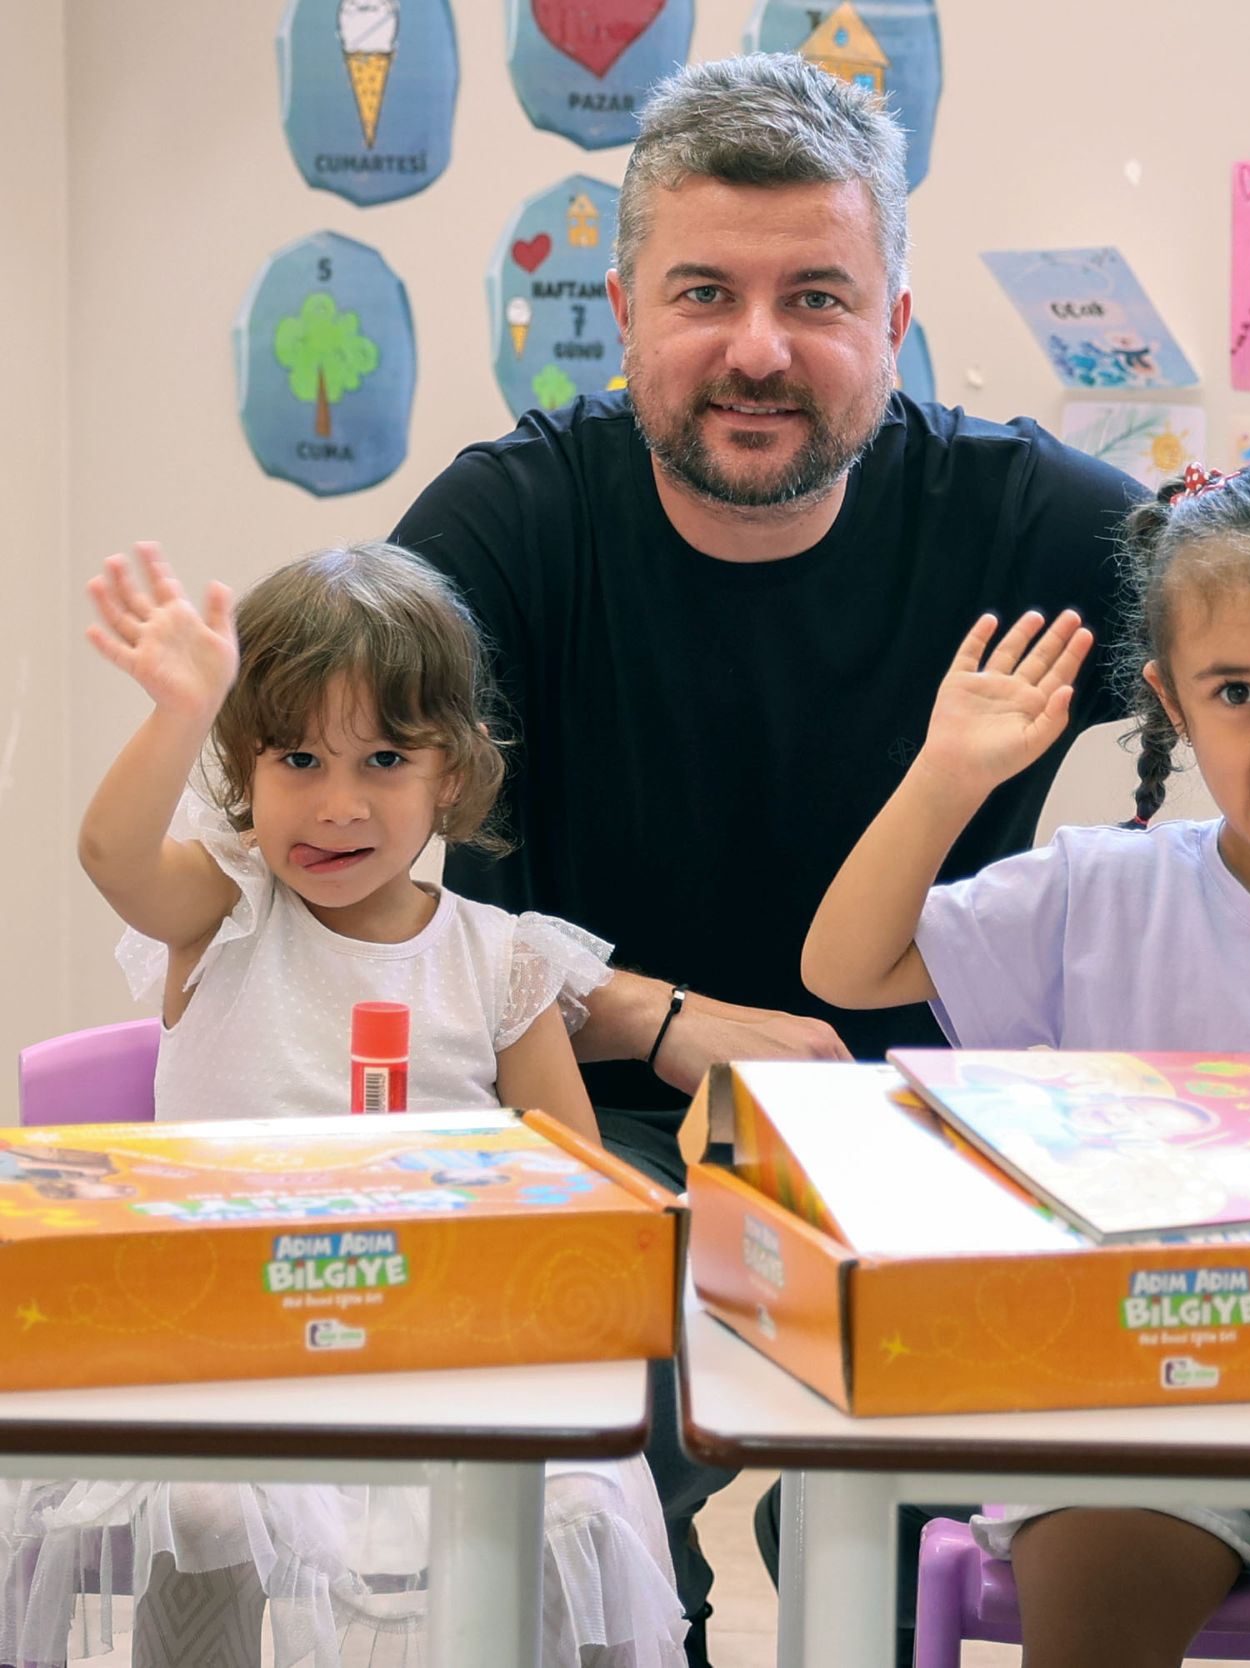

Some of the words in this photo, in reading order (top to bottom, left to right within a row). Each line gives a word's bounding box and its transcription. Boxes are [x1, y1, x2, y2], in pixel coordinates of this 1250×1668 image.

[566, 91, 635, 112] PAZAR
[532, 281, 607, 298] HAFTAN
[571, 304, 585, 337] 7
[275, 1235, 332, 1259] ADIM
[339, 1232, 394, 1256] ADIM
[1133, 1271, 1188, 1297] ADIM
[1194, 1269, 1248, 1293] ADIM
